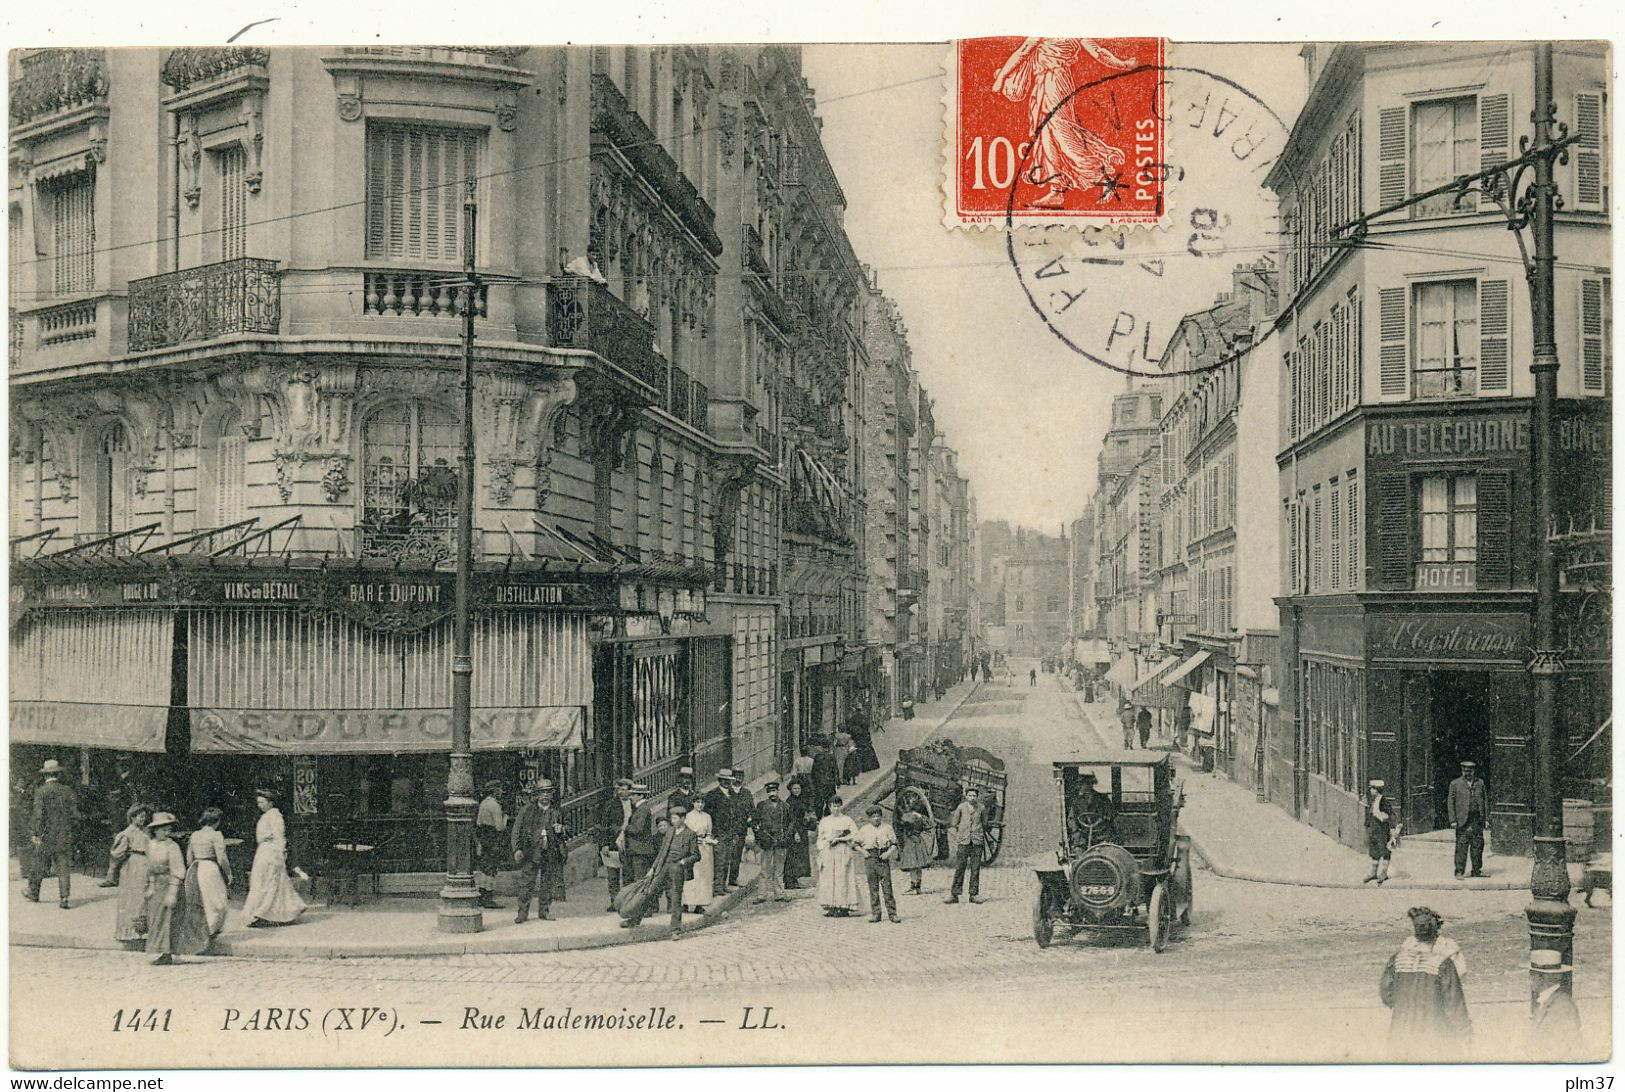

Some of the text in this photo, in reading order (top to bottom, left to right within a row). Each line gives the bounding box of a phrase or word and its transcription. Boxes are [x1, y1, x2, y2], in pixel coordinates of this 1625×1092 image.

[1135, 118, 1155, 202] POSTES
[1369, 418, 1528, 455] AU TELEPHONE
[1418, 567, 1474, 587] HOTEL
[224, 582, 251, 600] VINS
[251, 588, 262, 599] en
[350, 583, 441, 603] BAR E DUPONT
[496, 585, 563, 603] DISTILLATION
[296, 768, 315, 784] 20
[519, 769, 535, 781] 60
